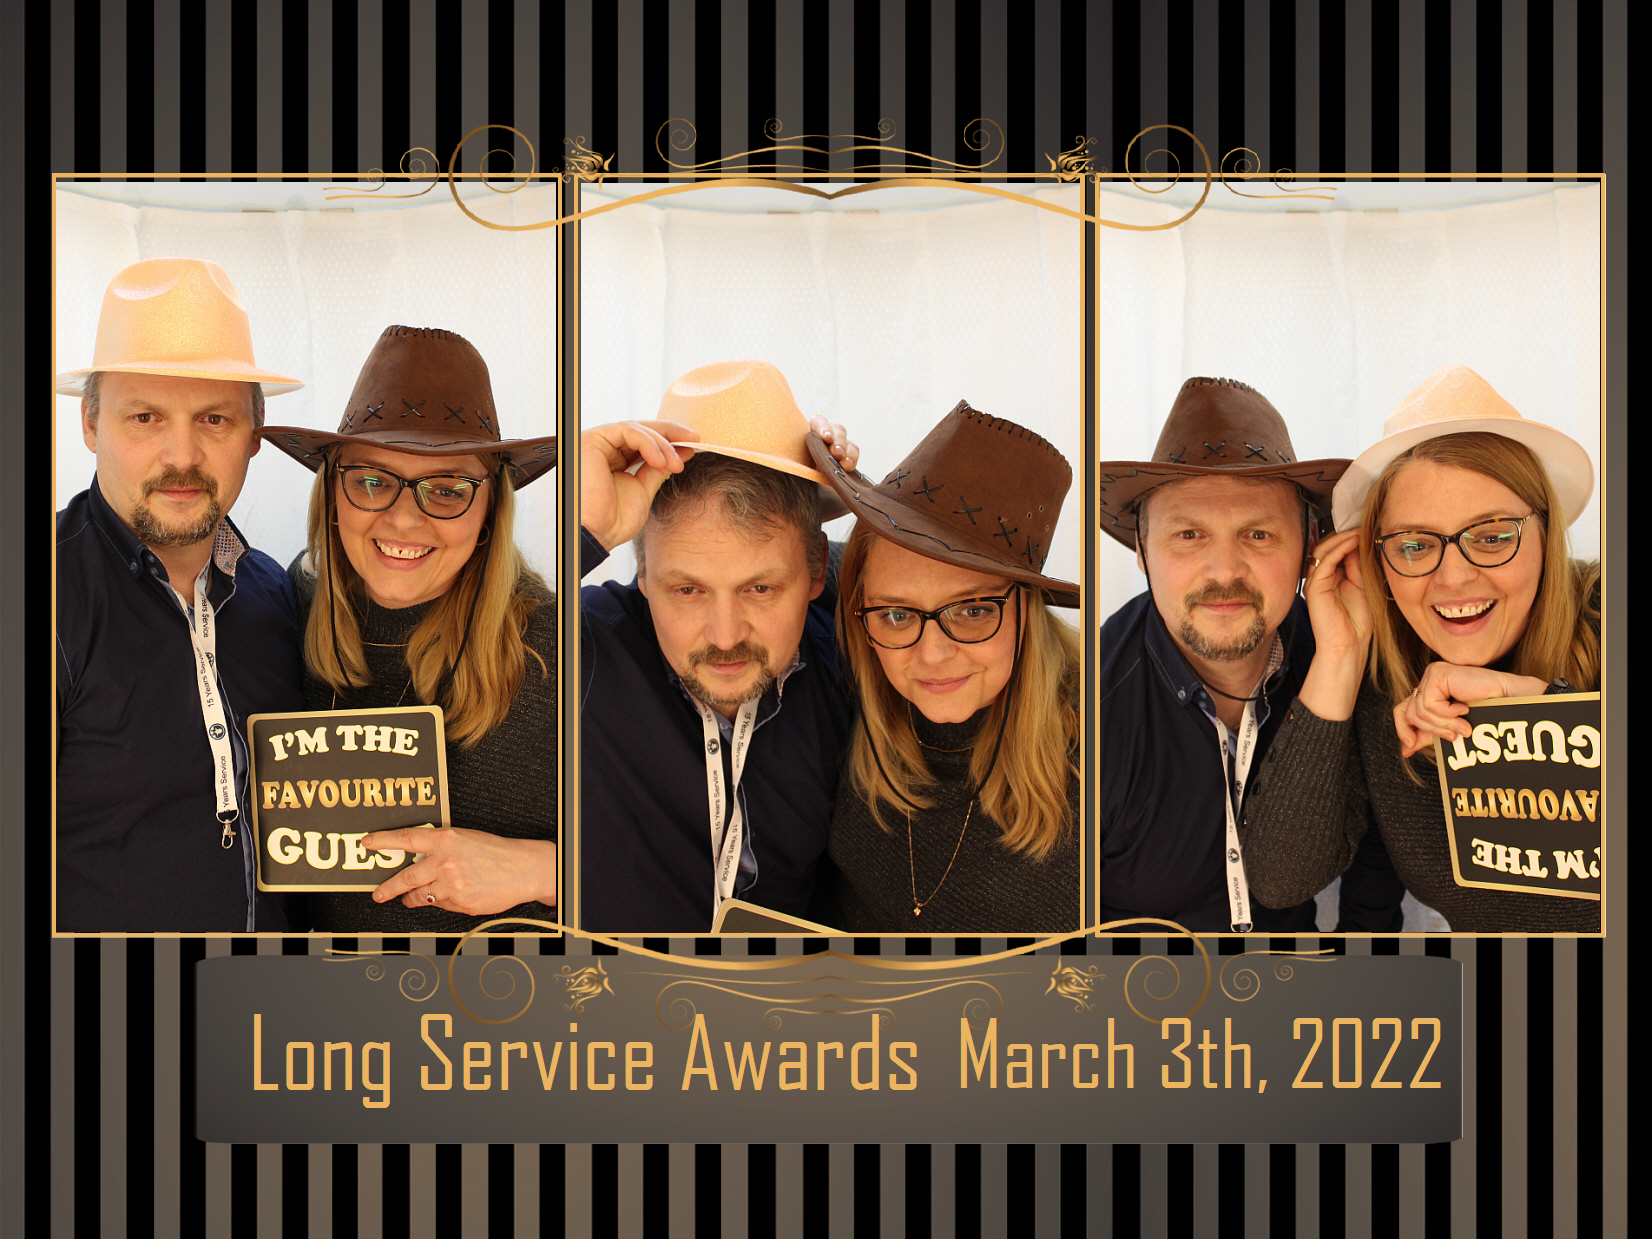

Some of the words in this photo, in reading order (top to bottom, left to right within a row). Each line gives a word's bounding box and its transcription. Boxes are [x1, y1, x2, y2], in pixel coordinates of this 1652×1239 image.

[201, 613, 210, 638] Service
[202, 675, 212, 698] Years
[738, 720, 750, 740] Years
[1245, 719, 1256, 739] Years
[268, 726, 330, 762] I'M
[335, 724, 420, 757] THE
[735, 741, 745, 769] Service
[1240, 739, 1251, 767] Service
[1447, 720, 1600, 771] GUEST
[220, 755, 228, 784] Service
[222, 785, 230, 808] Years
[261, 776, 437, 810] FAVOURITE
[1451, 787, 1600, 823] AVOURITE
[714, 821, 721, 831] 15
[266, 822, 436, 870] GUES
[728, 834, 738, 854] Years
[721, 855, 734, 882] Service
[1471, 837, 1549, 879] THE
[1233, 876, 1242, 901] Service
[1236, 901, 1244, 921] Years
